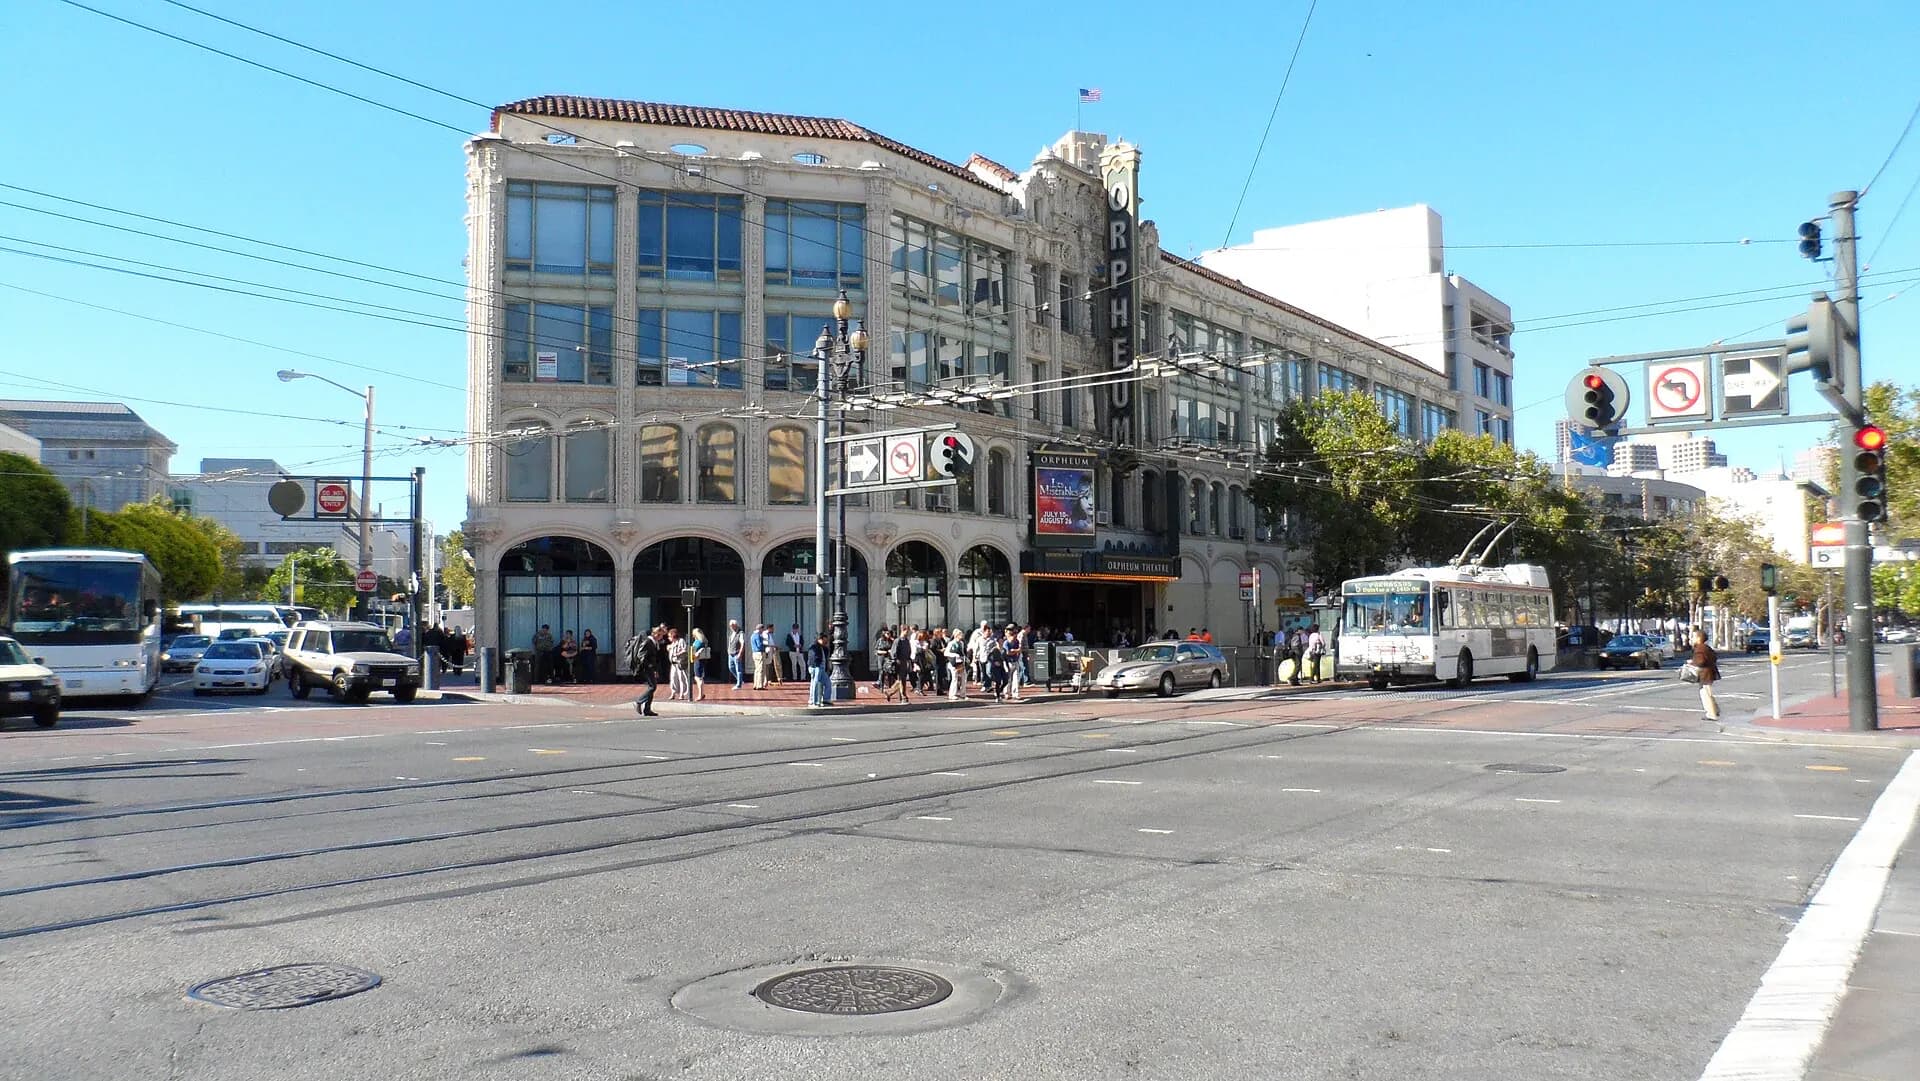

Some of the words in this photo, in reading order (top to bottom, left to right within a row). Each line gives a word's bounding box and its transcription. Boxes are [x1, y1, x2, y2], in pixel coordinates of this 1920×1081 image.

[1109, 182, 1130, 448] ORPHEUM
[1040, 456, 1089, 465] ORPHEUM
[1040, 517, 1064, 525] AUGUST
[1107, 560, 1139, 572] ORPHEUM
[1142, 562, 1169, 573] THEATRE
[790, 575, 814, 583] MARKET
